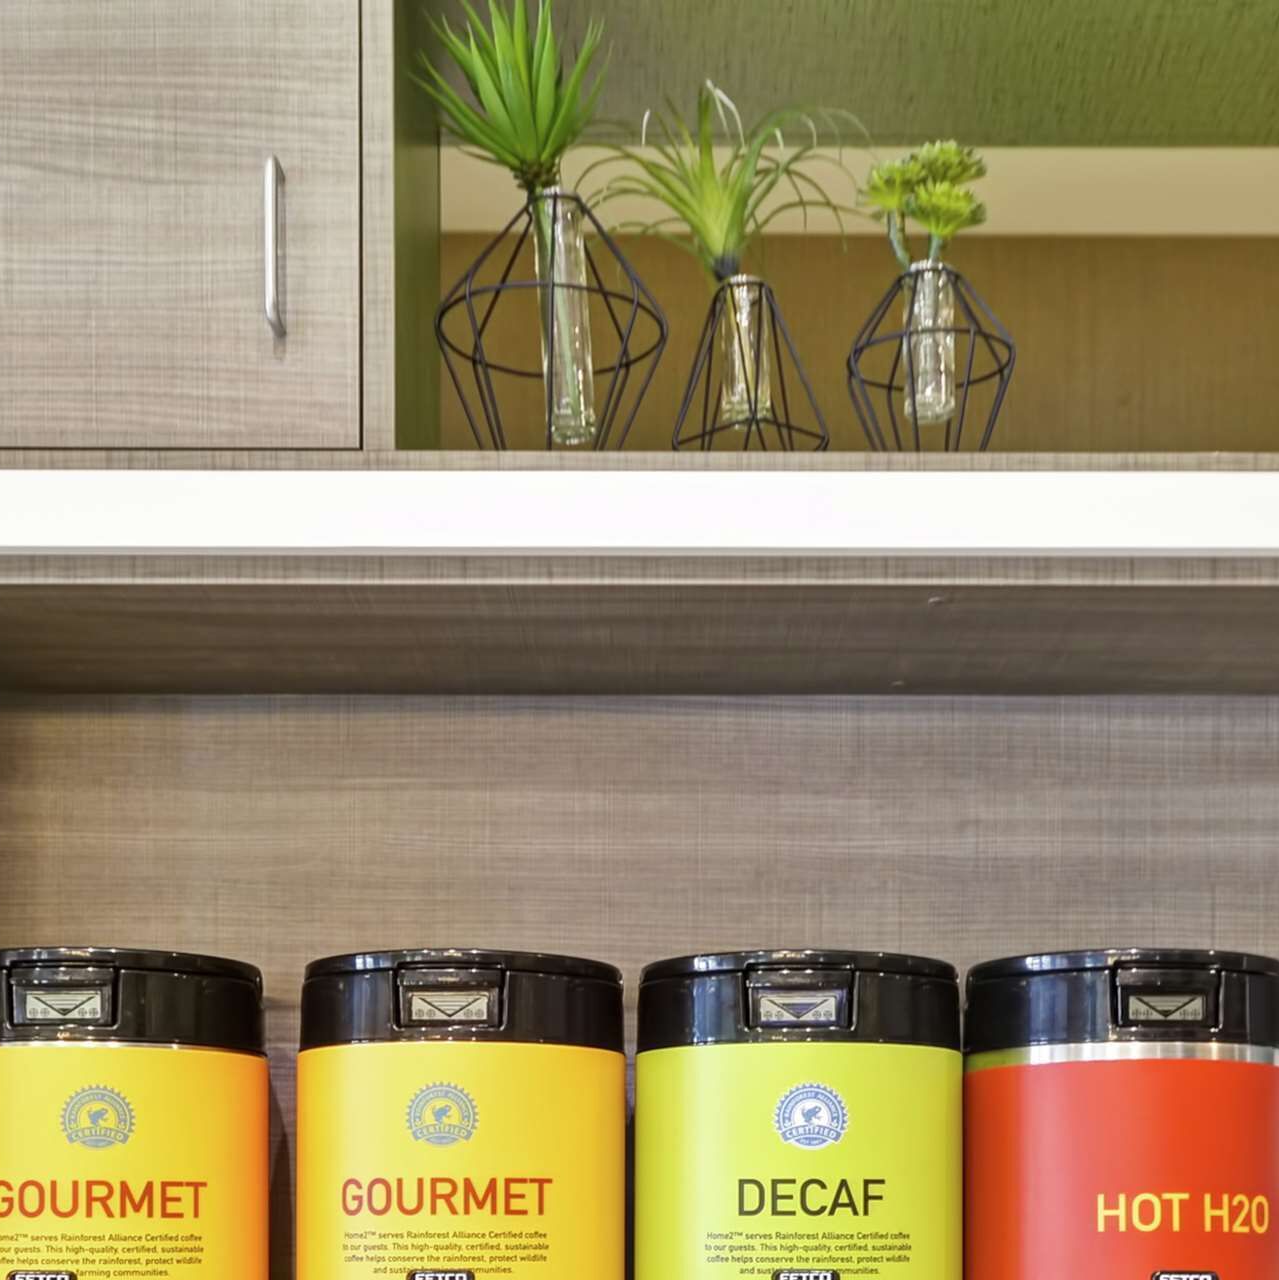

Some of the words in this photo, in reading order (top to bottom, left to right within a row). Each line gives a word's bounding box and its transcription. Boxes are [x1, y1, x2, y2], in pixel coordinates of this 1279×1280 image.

[785, 1126, 837, 1139] CERTIFIED
[341, 1177, 554, 1217] GOURMET
[738, 1178, 886, 1217] DECAF
[1096, 1192, 1190, 1233] HOT
[30, 1233, 58, 1242] serves
[61, 1233, 105, 1242] Rainforest
[108, 1233, 143, 1242] Alliance
[145, 1233, 179, 1242] Certified
[378, 1231, 404, 1239] serves
[406, 1231, 450, 1239] Rainforest
[452, 1231, 486, 1239] Alliance
[488, 1231, 523, 1239] Certified
[745, 1232, 773, 1240] serves
[776, 1232, 820, 1240] Rainforest
[822, 1232, 855, 1240] Alliance
[856, 1232, 889, 1240] Certified
[45, 1245, 62, 1253] This
[161, 1245, 204, 1253] sustainable
[392, 1242, 409, 1251] This
[504, 1242, 550, 1251] sustainable
[760, 1243, 778, 1251] This
[872, 1243, 912, 1251] sustainable
[16, 1257, 39, 1267] helps
[41, 1257, 80, 1265] conserve
[145, 1257, 174, 1267] protect
[344, 1254, 364, 1262] coffee
[366, 1254, 386, 1264] helps
[388, 1254, 425, 1262] conserve
[489, 1254, 518, 1264] protect
[706, 1255, 730, 1263] coffee
[732, 1255, 754, 1265] helps
[755, 1255, 794, 1263] conserve
[856, 1255, 884, 1265] protect
[76, 1268, 111, 1278] farming
[373, 1266, 387, 1274] and
[739, 1266, 755, 1275] and
